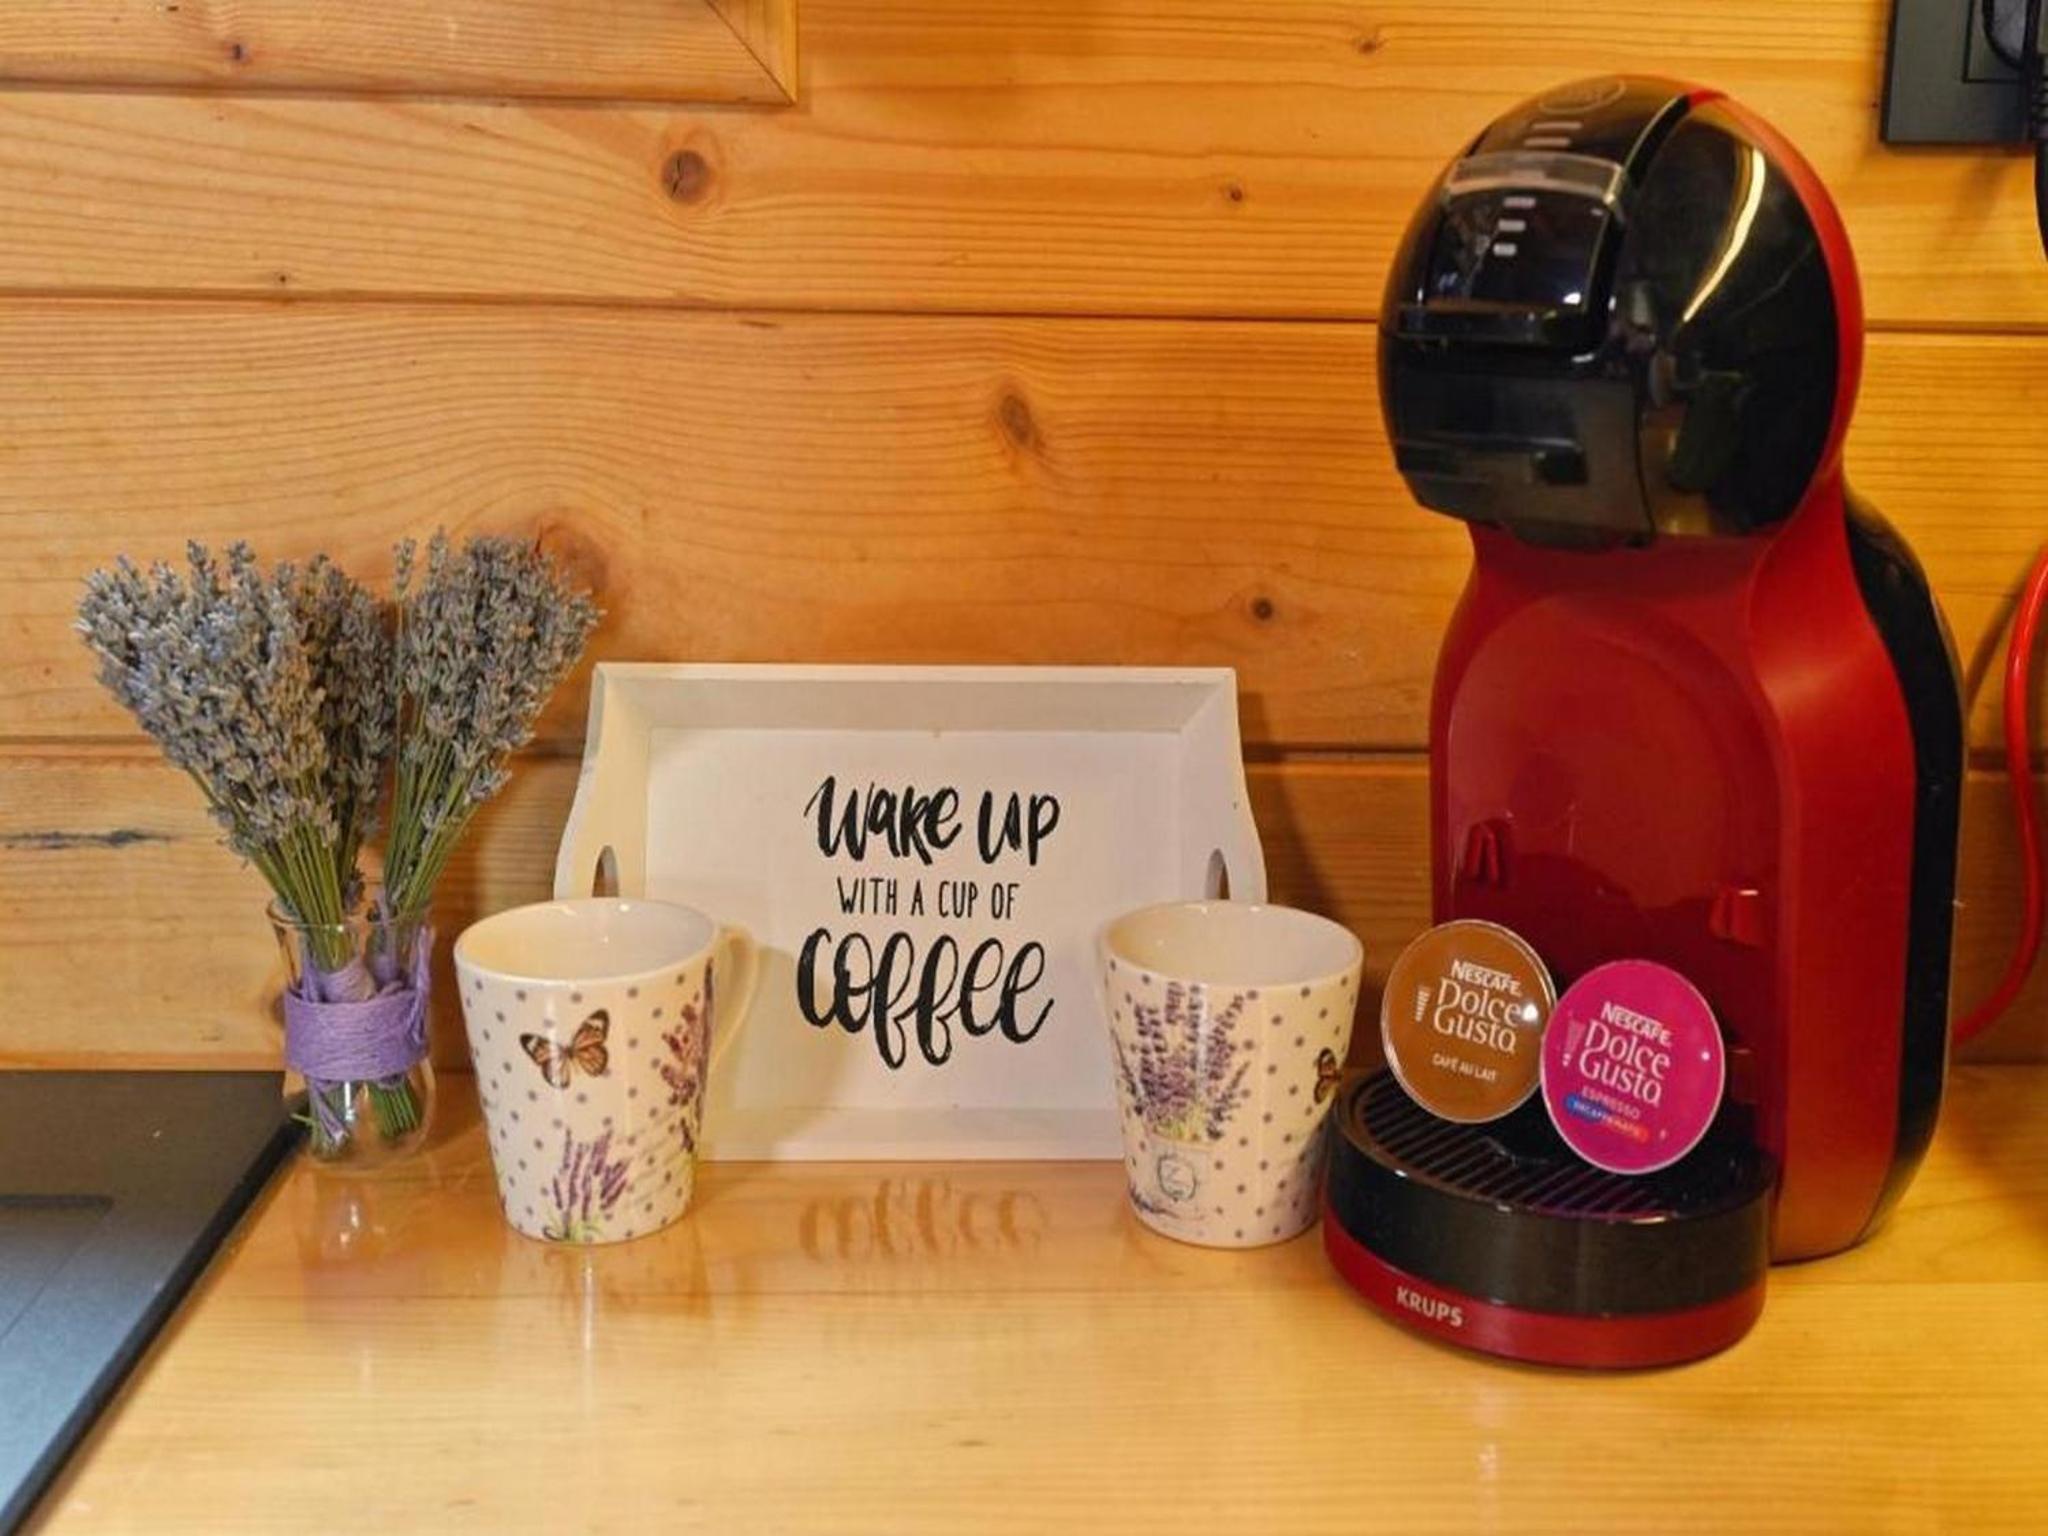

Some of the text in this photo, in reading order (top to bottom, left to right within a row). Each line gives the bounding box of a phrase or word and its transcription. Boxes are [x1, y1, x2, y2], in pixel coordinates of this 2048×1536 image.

[837, 875, 1020, 921] WITH A CUP OF
[1396, 1285, 1463, 1328] KRUPS
